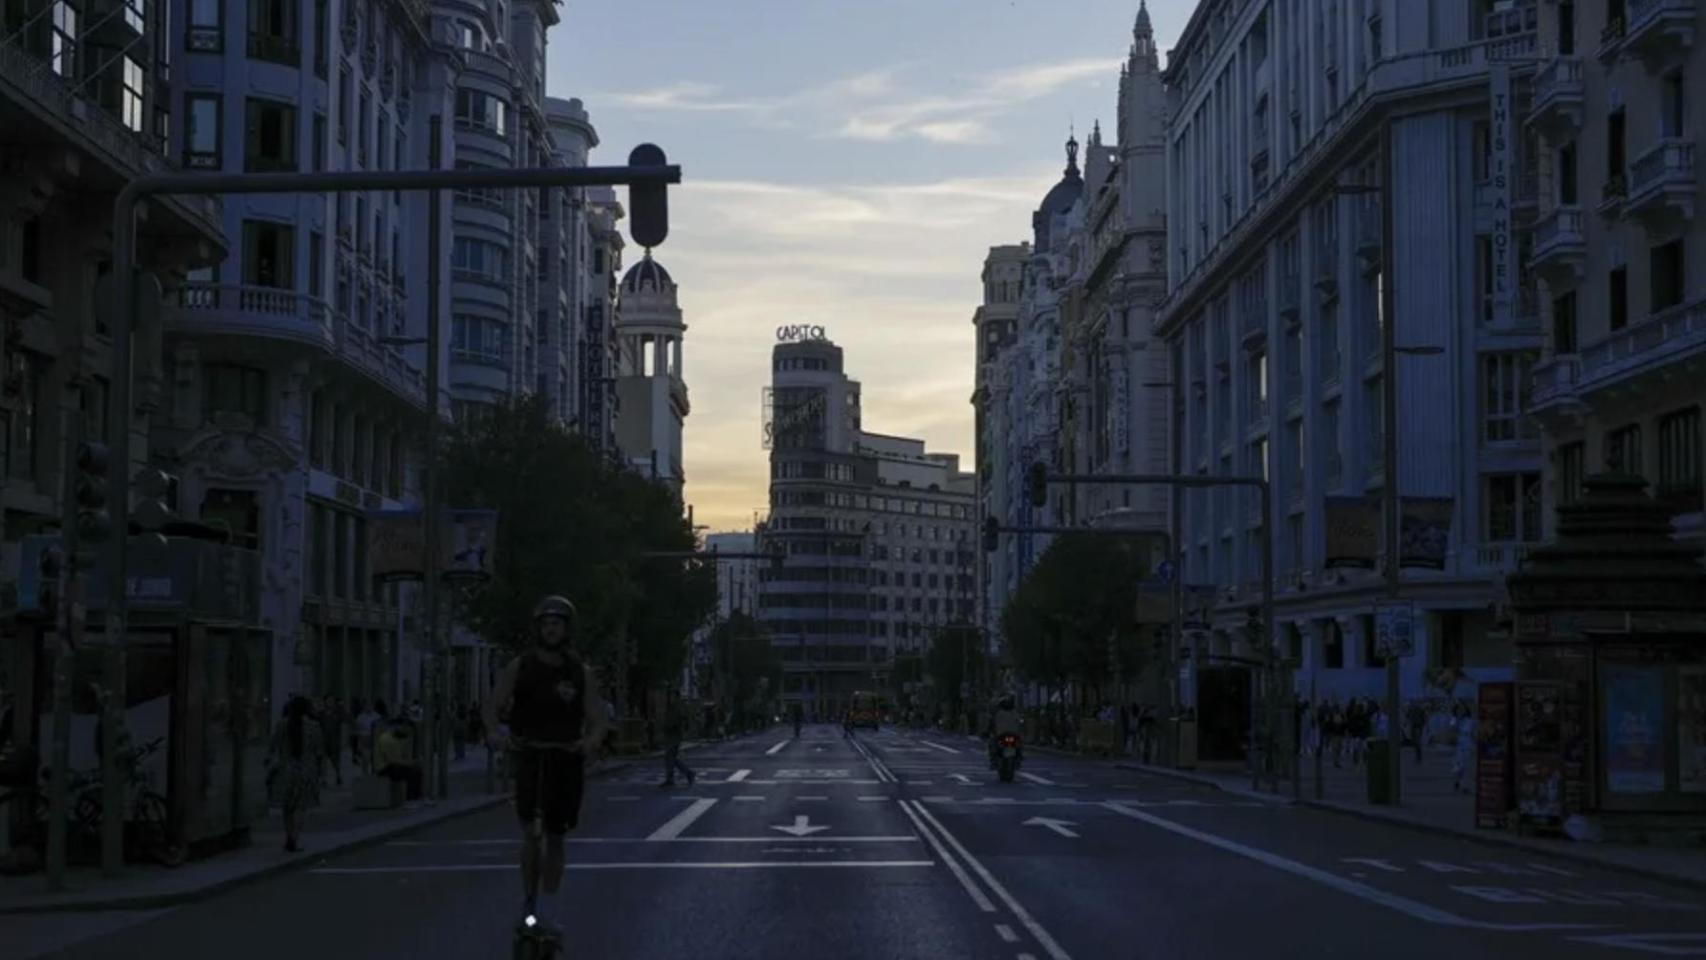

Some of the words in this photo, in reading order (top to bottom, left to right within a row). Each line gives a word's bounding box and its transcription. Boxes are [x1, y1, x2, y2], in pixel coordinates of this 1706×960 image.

[1495, 94, 1506, 152] THIS
[1495, 159, 1506, 188] IS
[1495, 198, 1507, 210] A
[1495, 220, 1507, 292] HOTEL
[776, 324, 827, 342] CAPITOL
